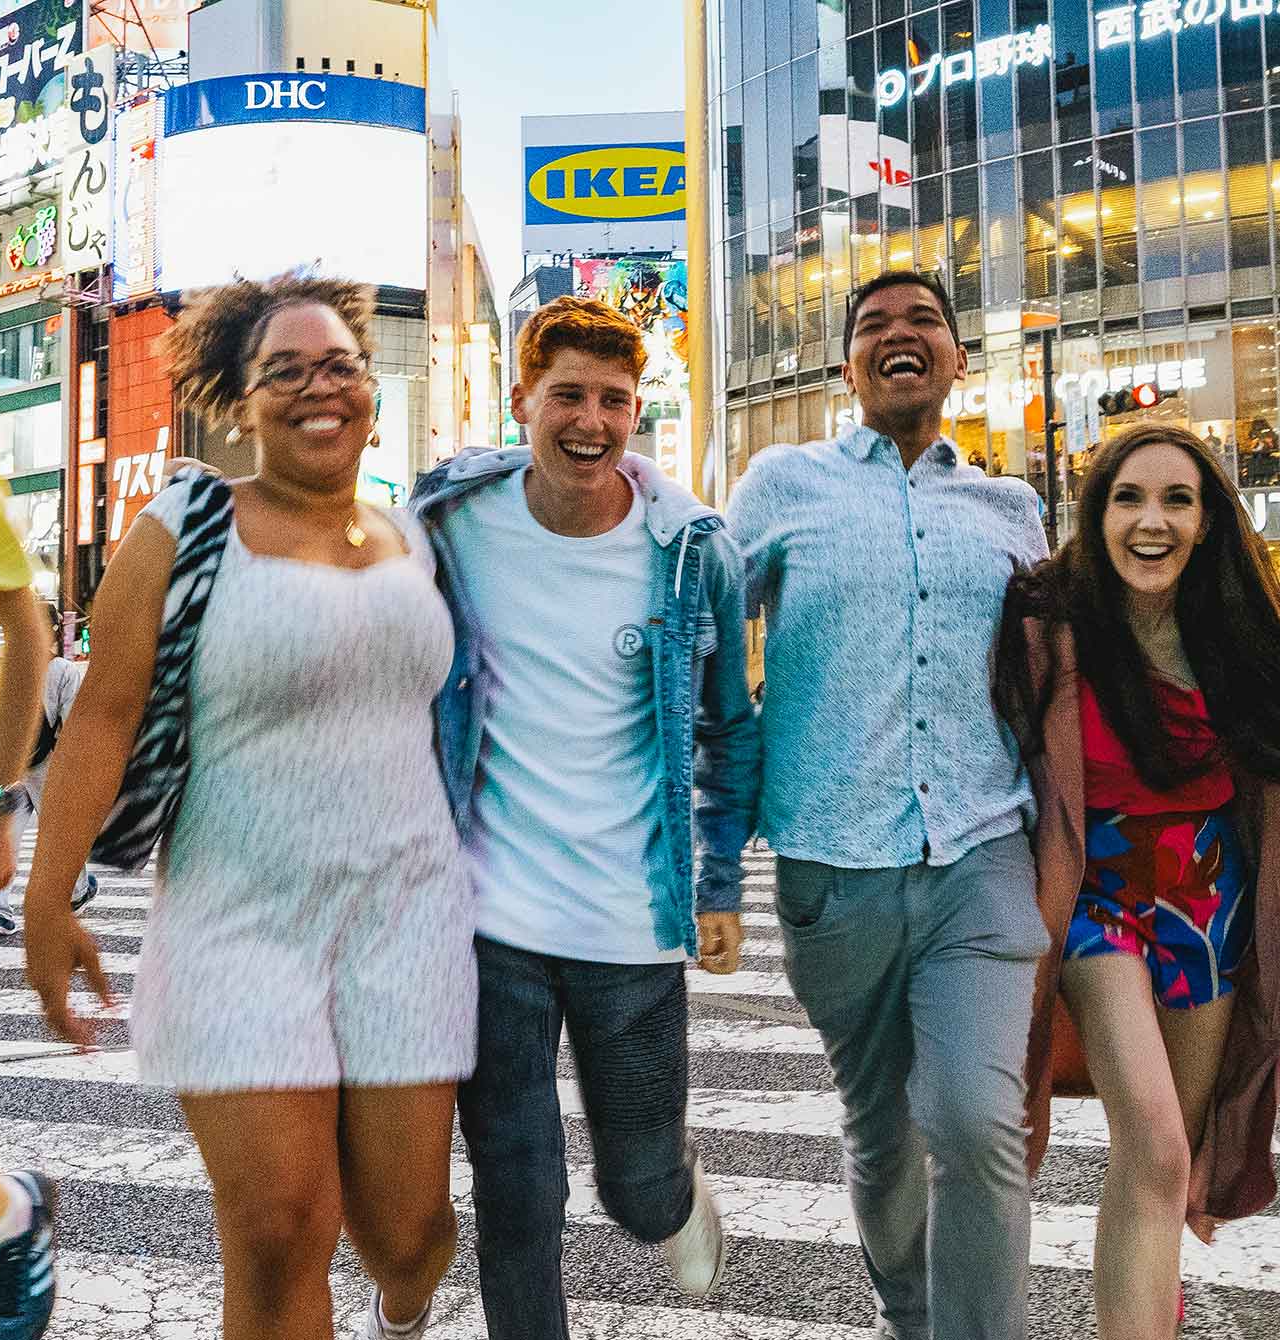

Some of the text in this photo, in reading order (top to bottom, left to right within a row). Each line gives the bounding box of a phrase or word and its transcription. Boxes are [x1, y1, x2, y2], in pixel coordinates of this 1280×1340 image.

[245, 81, 326, 110] DHC
[69, 57, 108, 260] もんじゃ
[545, 165, 686, 200] IKEA
[1055, 357, 1208, 398] COFFEE
